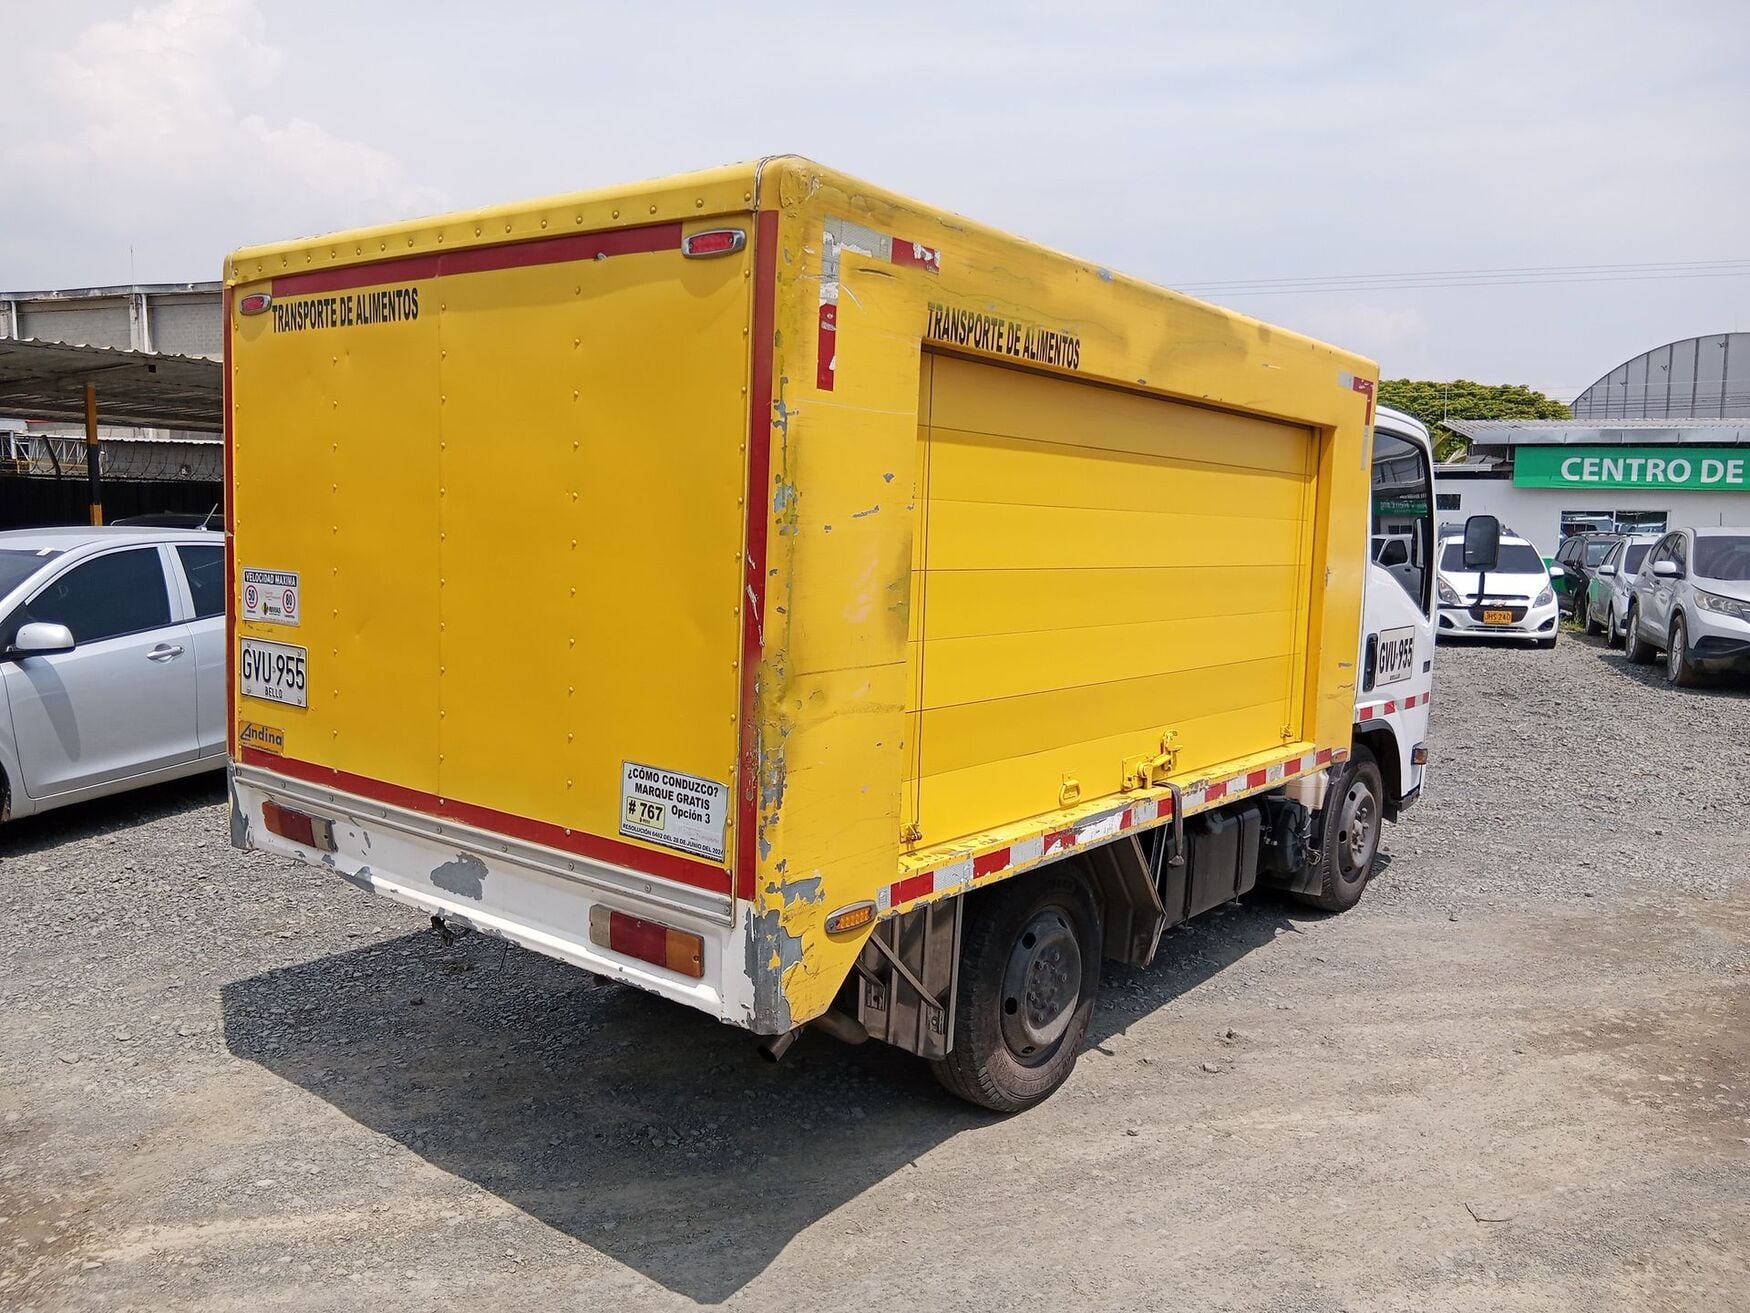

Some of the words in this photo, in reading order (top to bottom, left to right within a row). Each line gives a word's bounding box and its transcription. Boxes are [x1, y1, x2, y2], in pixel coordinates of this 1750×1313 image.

[272, 298, 337, 333] TRANSPORTE
[340, 296, 353, 327] DE
[356, 288, 418, 325] ALIMENTOS
[927, 303, 1004, 352] TRANSPORTE
[1006, 322, 1021, 357] DE
[1023, 327, 1080, 369] ALIMENTOS
[1560, 457, 1692, 483] CENTRO
[1701, 459, 1745, 484] DE
[246, 572, 274, 584] VELOCIDAD
[265, 686, 282, 699] BELLO
[240, 723, 282, 746] Andina
[628, 768, 659, 783] ¿CÓMO
[662, 775, 719, 797] CONDUZCO?
[635, 783, 674, 801] MARQUE
[676, 793, 710, 810] GRATIS
[640, 802, 663, 821] 767
[671, 805, 702, 822] Opción
[704, 813, 711, 824] 3
[686, 840, 703, 850] JUNIO
